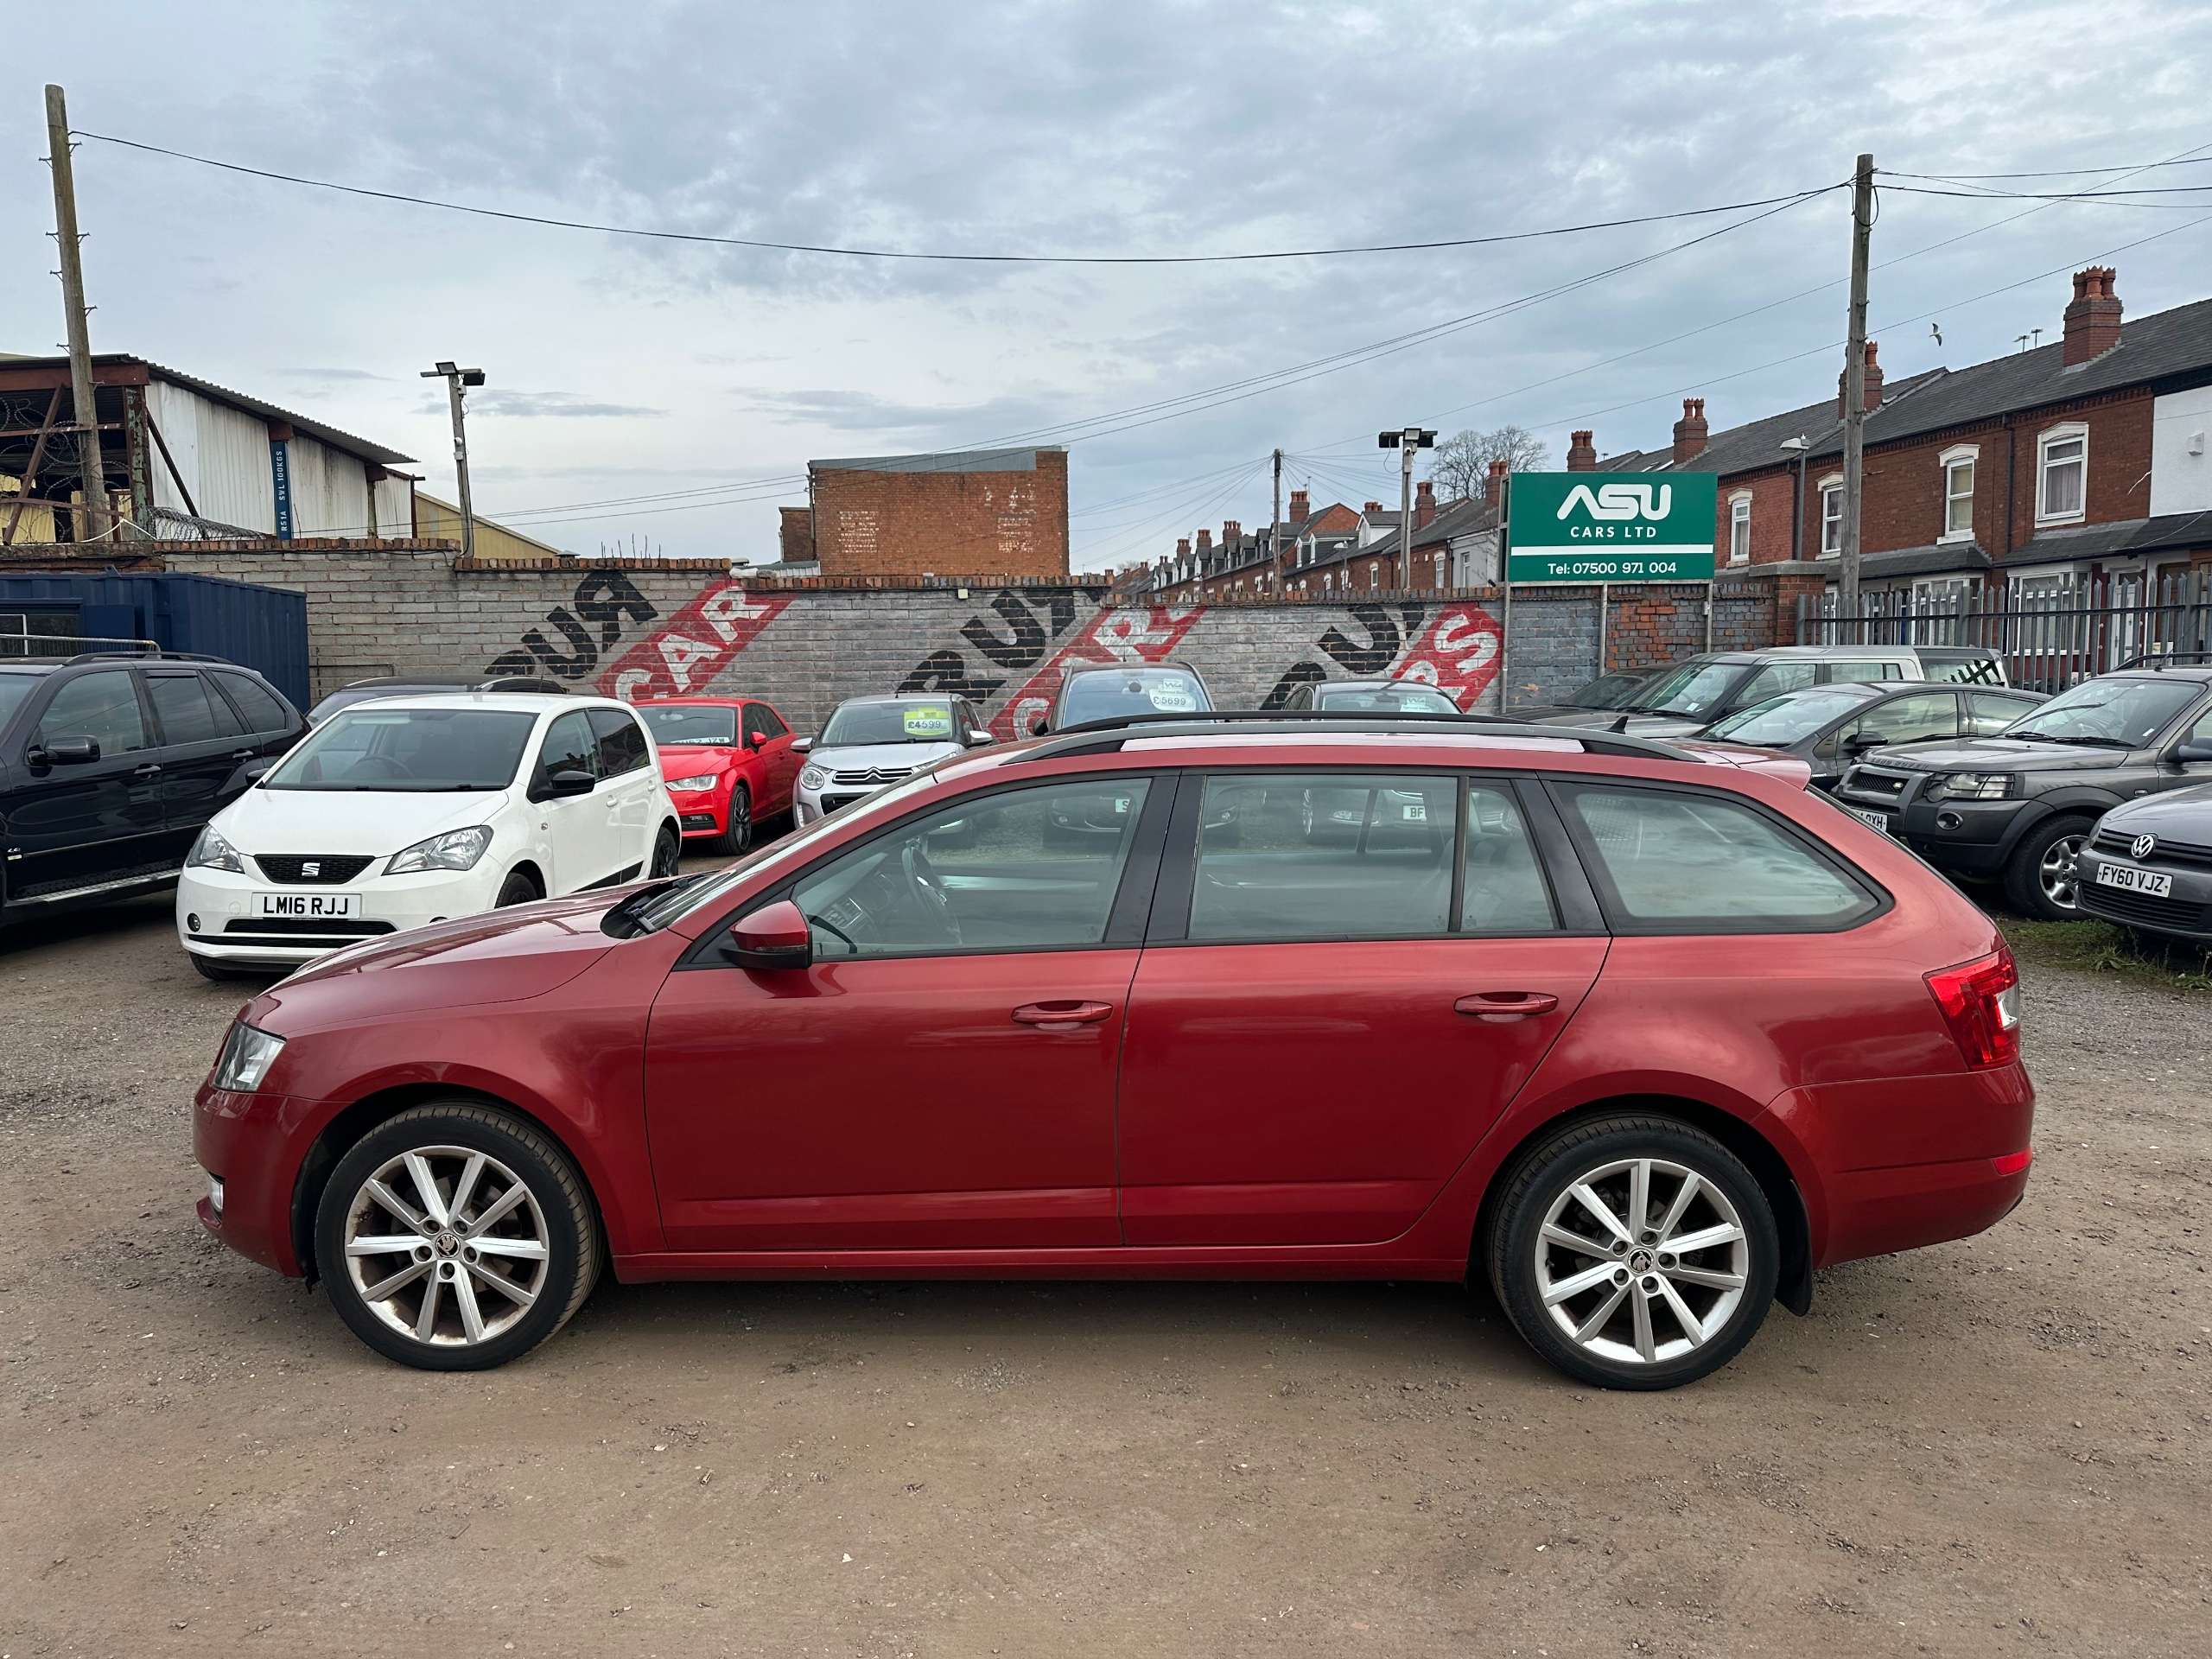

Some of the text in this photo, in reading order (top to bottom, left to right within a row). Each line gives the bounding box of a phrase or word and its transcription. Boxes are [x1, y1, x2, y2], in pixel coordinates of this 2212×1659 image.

[1557, 484, 1671, 520] ASU
[1571, 527, 1657, 537] CARS LTD
[1548, 562, 1677, 575] Tel: 07500 971 004
[907, 720, 941, 728] £4599
[2101, 866, 2165, 893] FY60 VJZ
[263, 896, 348, 915] LM16 RJJ
